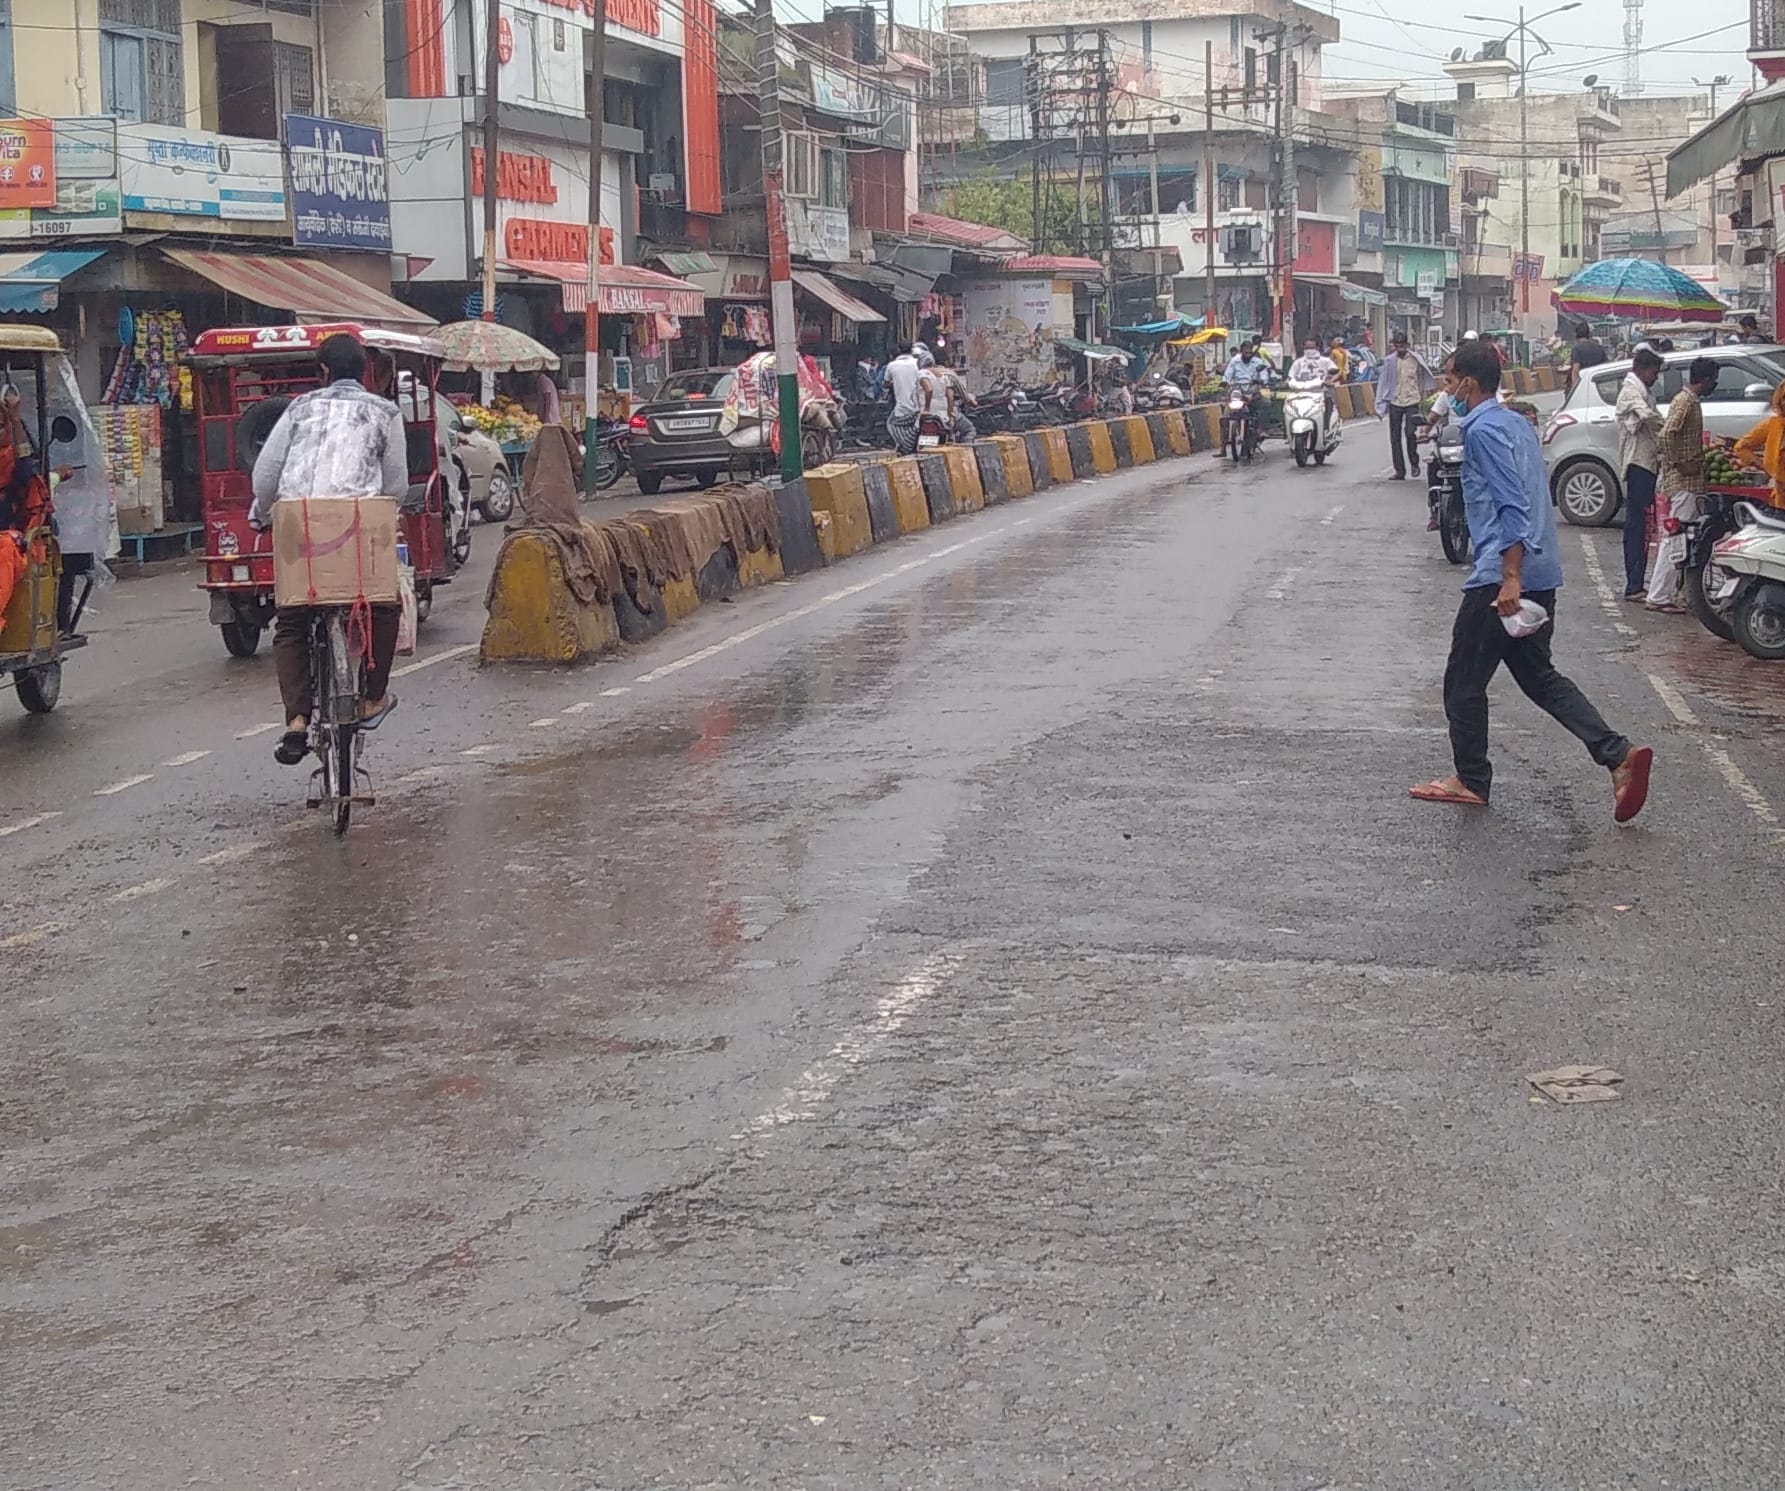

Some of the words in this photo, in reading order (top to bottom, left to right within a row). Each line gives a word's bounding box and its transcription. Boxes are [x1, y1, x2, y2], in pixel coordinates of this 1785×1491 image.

[0, 148, 21, 160] ita
[505, 218, 615, 264] GARMENS
[611, 289, 645, 311] BANSAL
